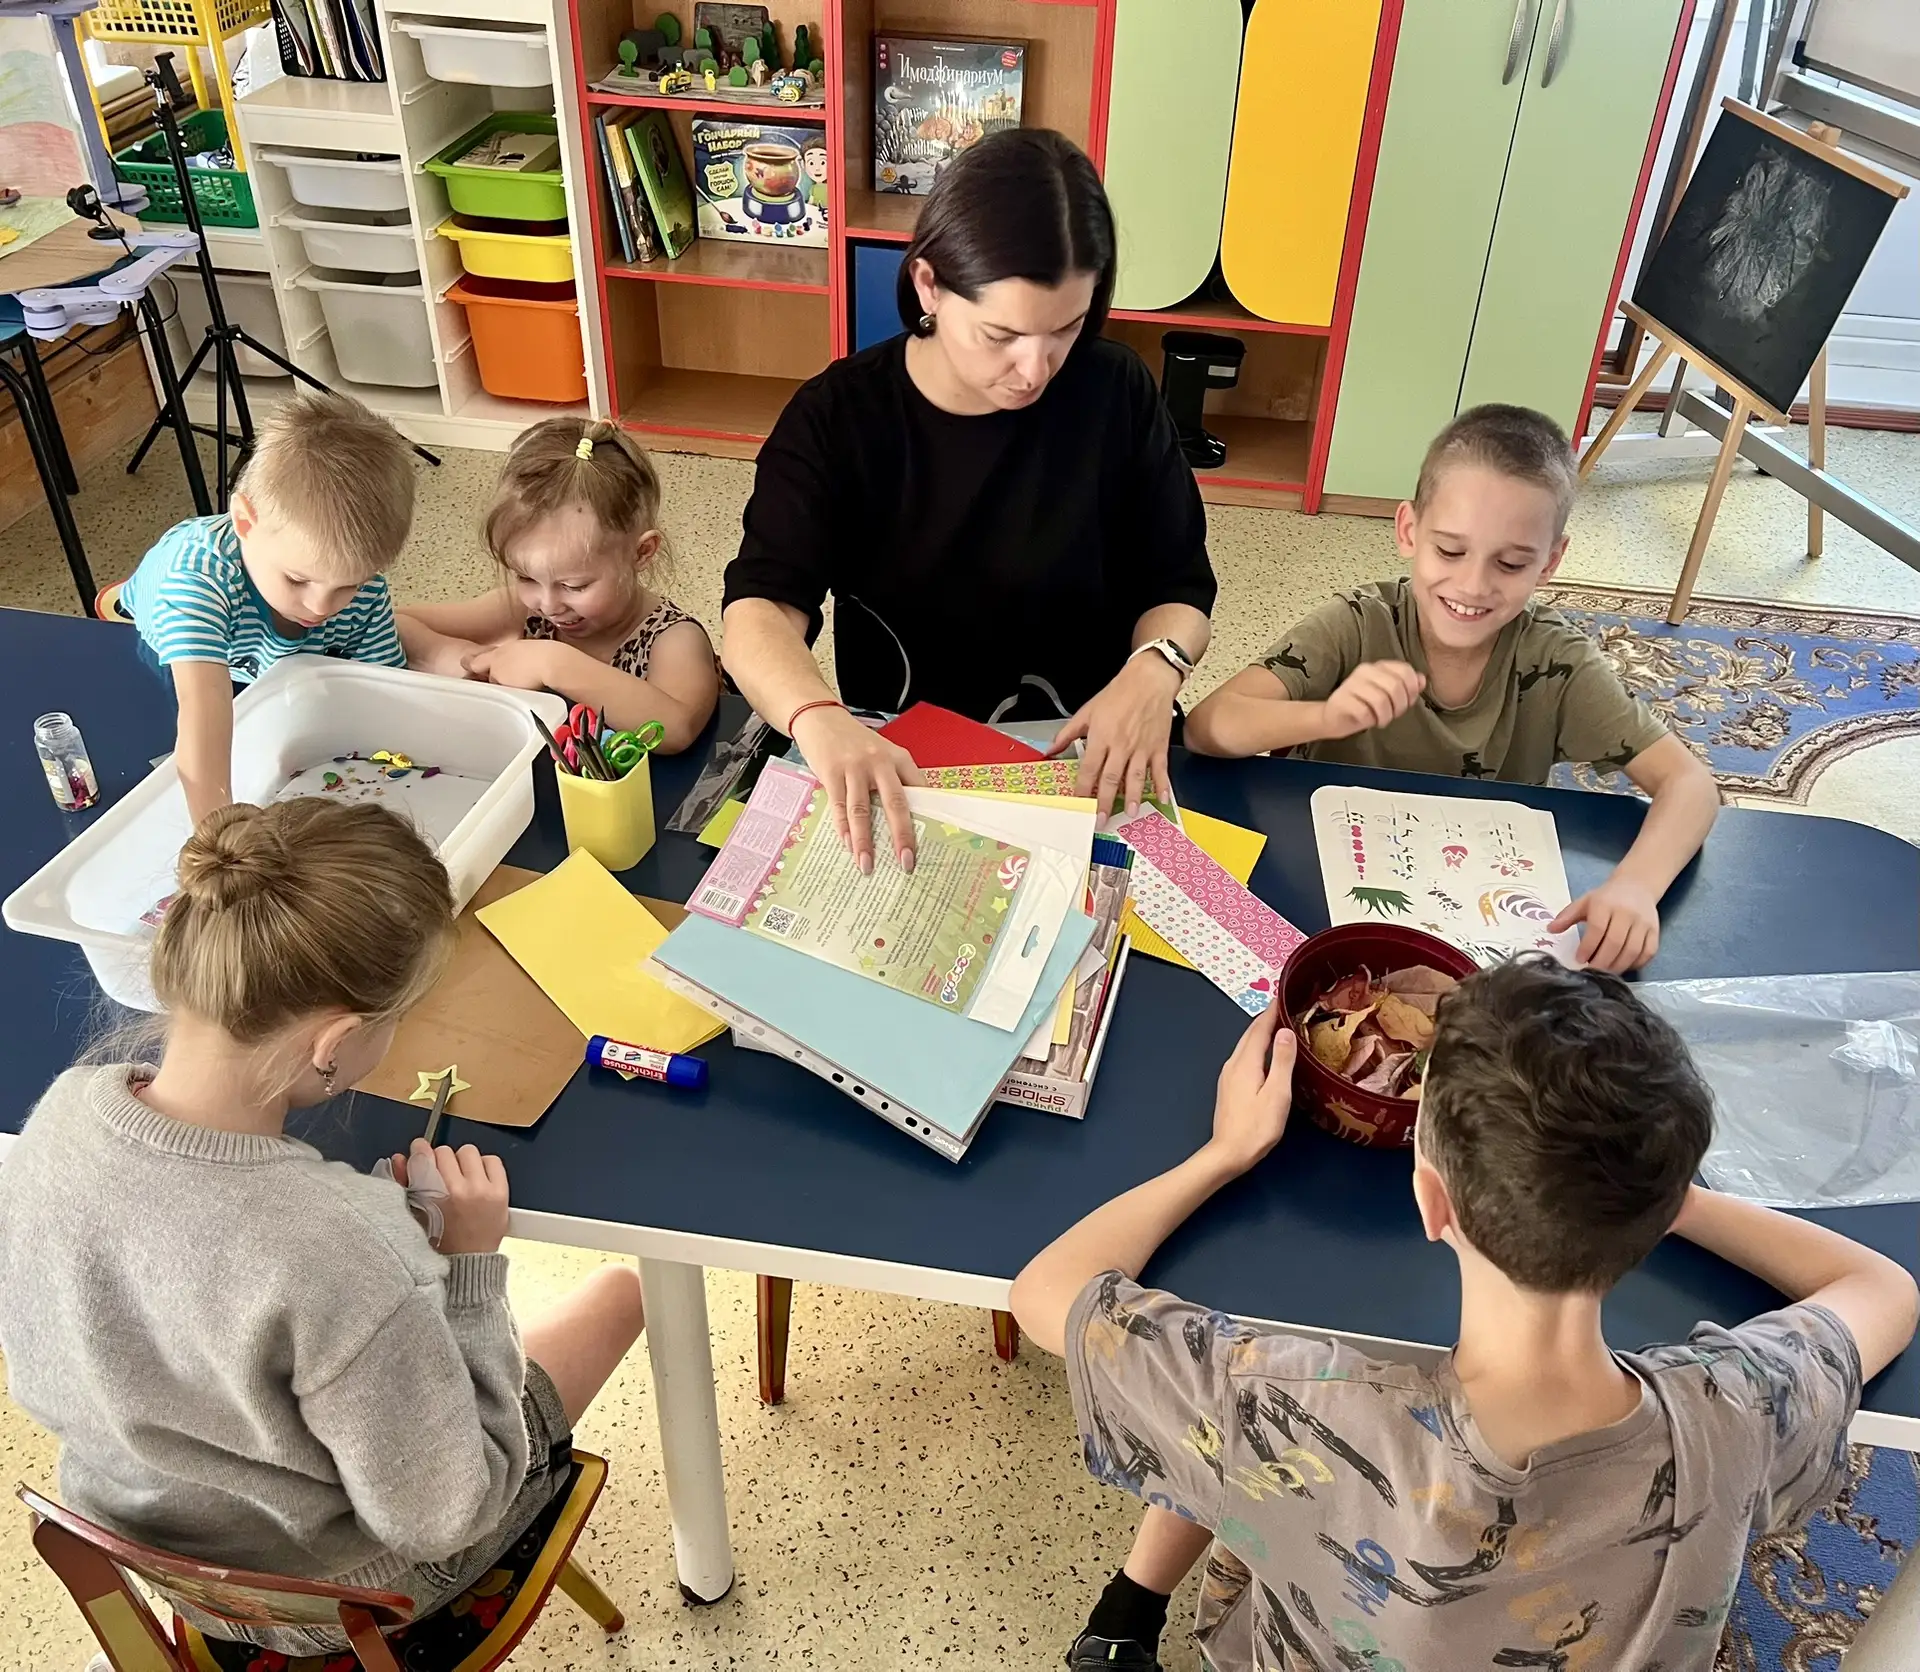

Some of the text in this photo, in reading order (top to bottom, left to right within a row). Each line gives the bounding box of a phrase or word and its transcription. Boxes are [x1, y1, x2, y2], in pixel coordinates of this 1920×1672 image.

[897, 53, 1003, 88] Имаджинариум
[707, 139, 743, 152] НАБОР
[603, 1059, 664, 1080] ErichKrause
